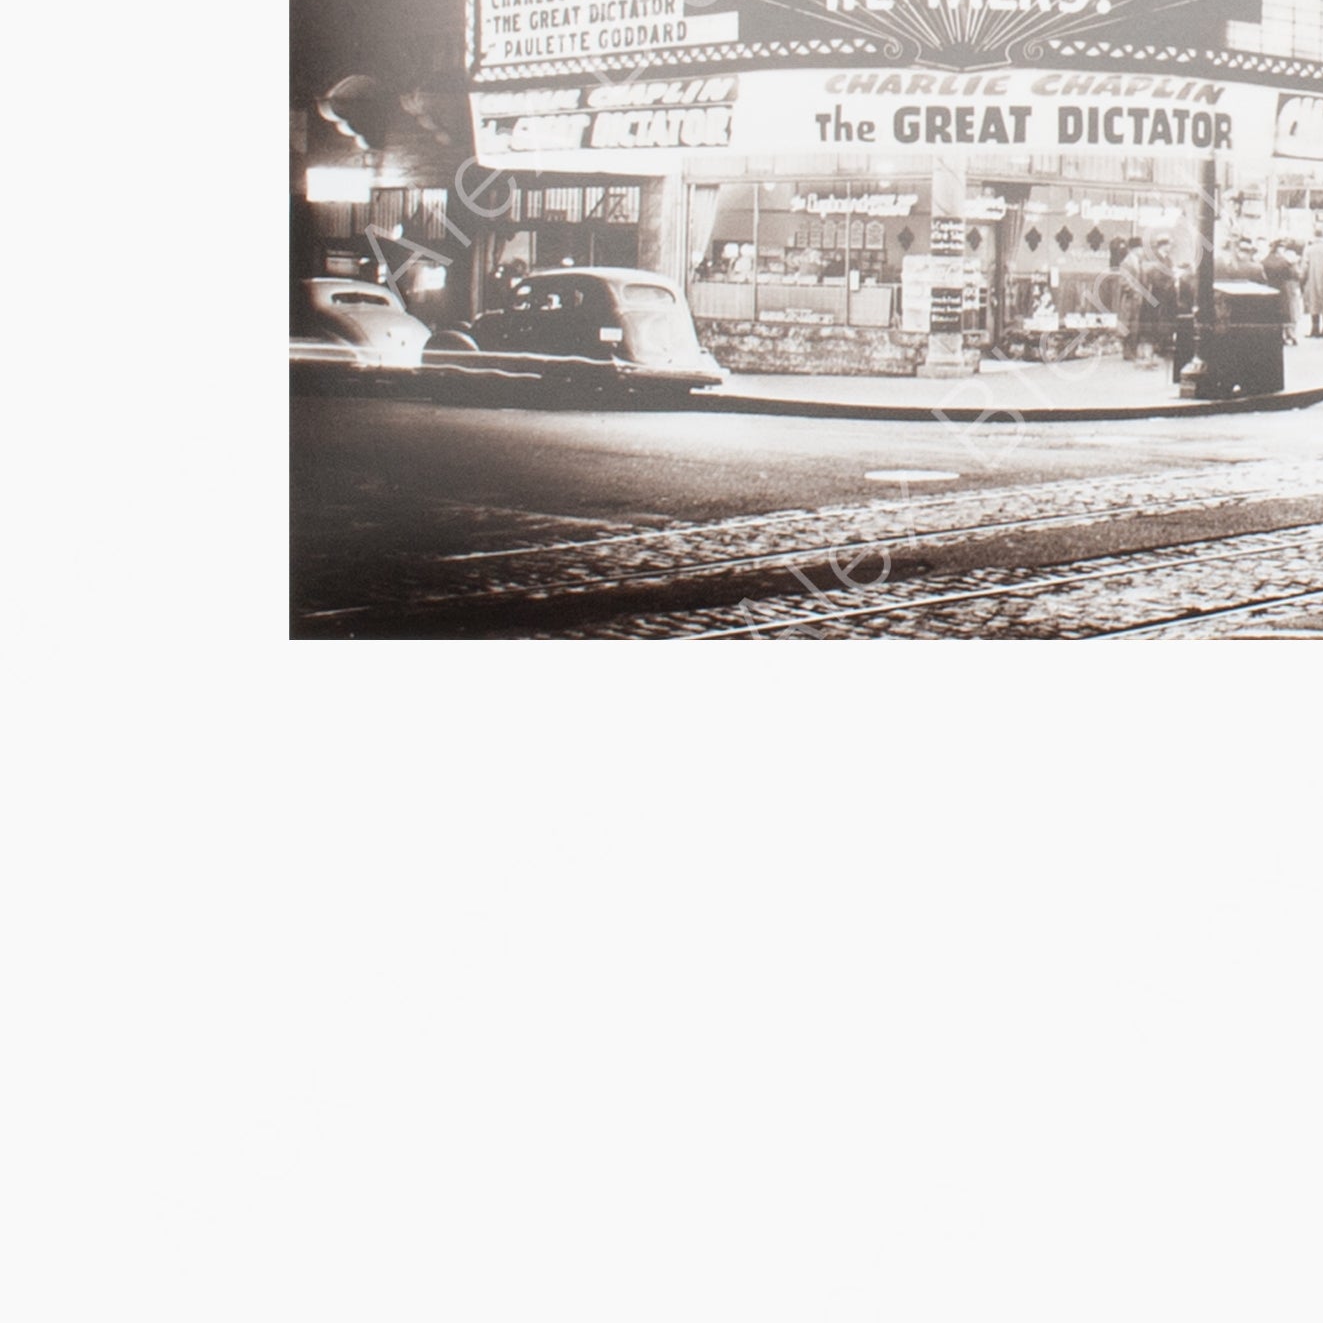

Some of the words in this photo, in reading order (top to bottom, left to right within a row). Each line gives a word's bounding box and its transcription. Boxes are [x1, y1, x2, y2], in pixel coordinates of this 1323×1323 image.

[529, 6, 581, 30] GREAT
[503, 31, 590, 59] PAULETTE
[598, 20, 688, 50] GODDARD
[822, 72, 1012, 97] CHARLIE
[1029, 73, 1226, 107] CHAPLIN
[892, 104, 1033, 145] GREAT
[1056, 105, 1234, 151] DICTATOR
